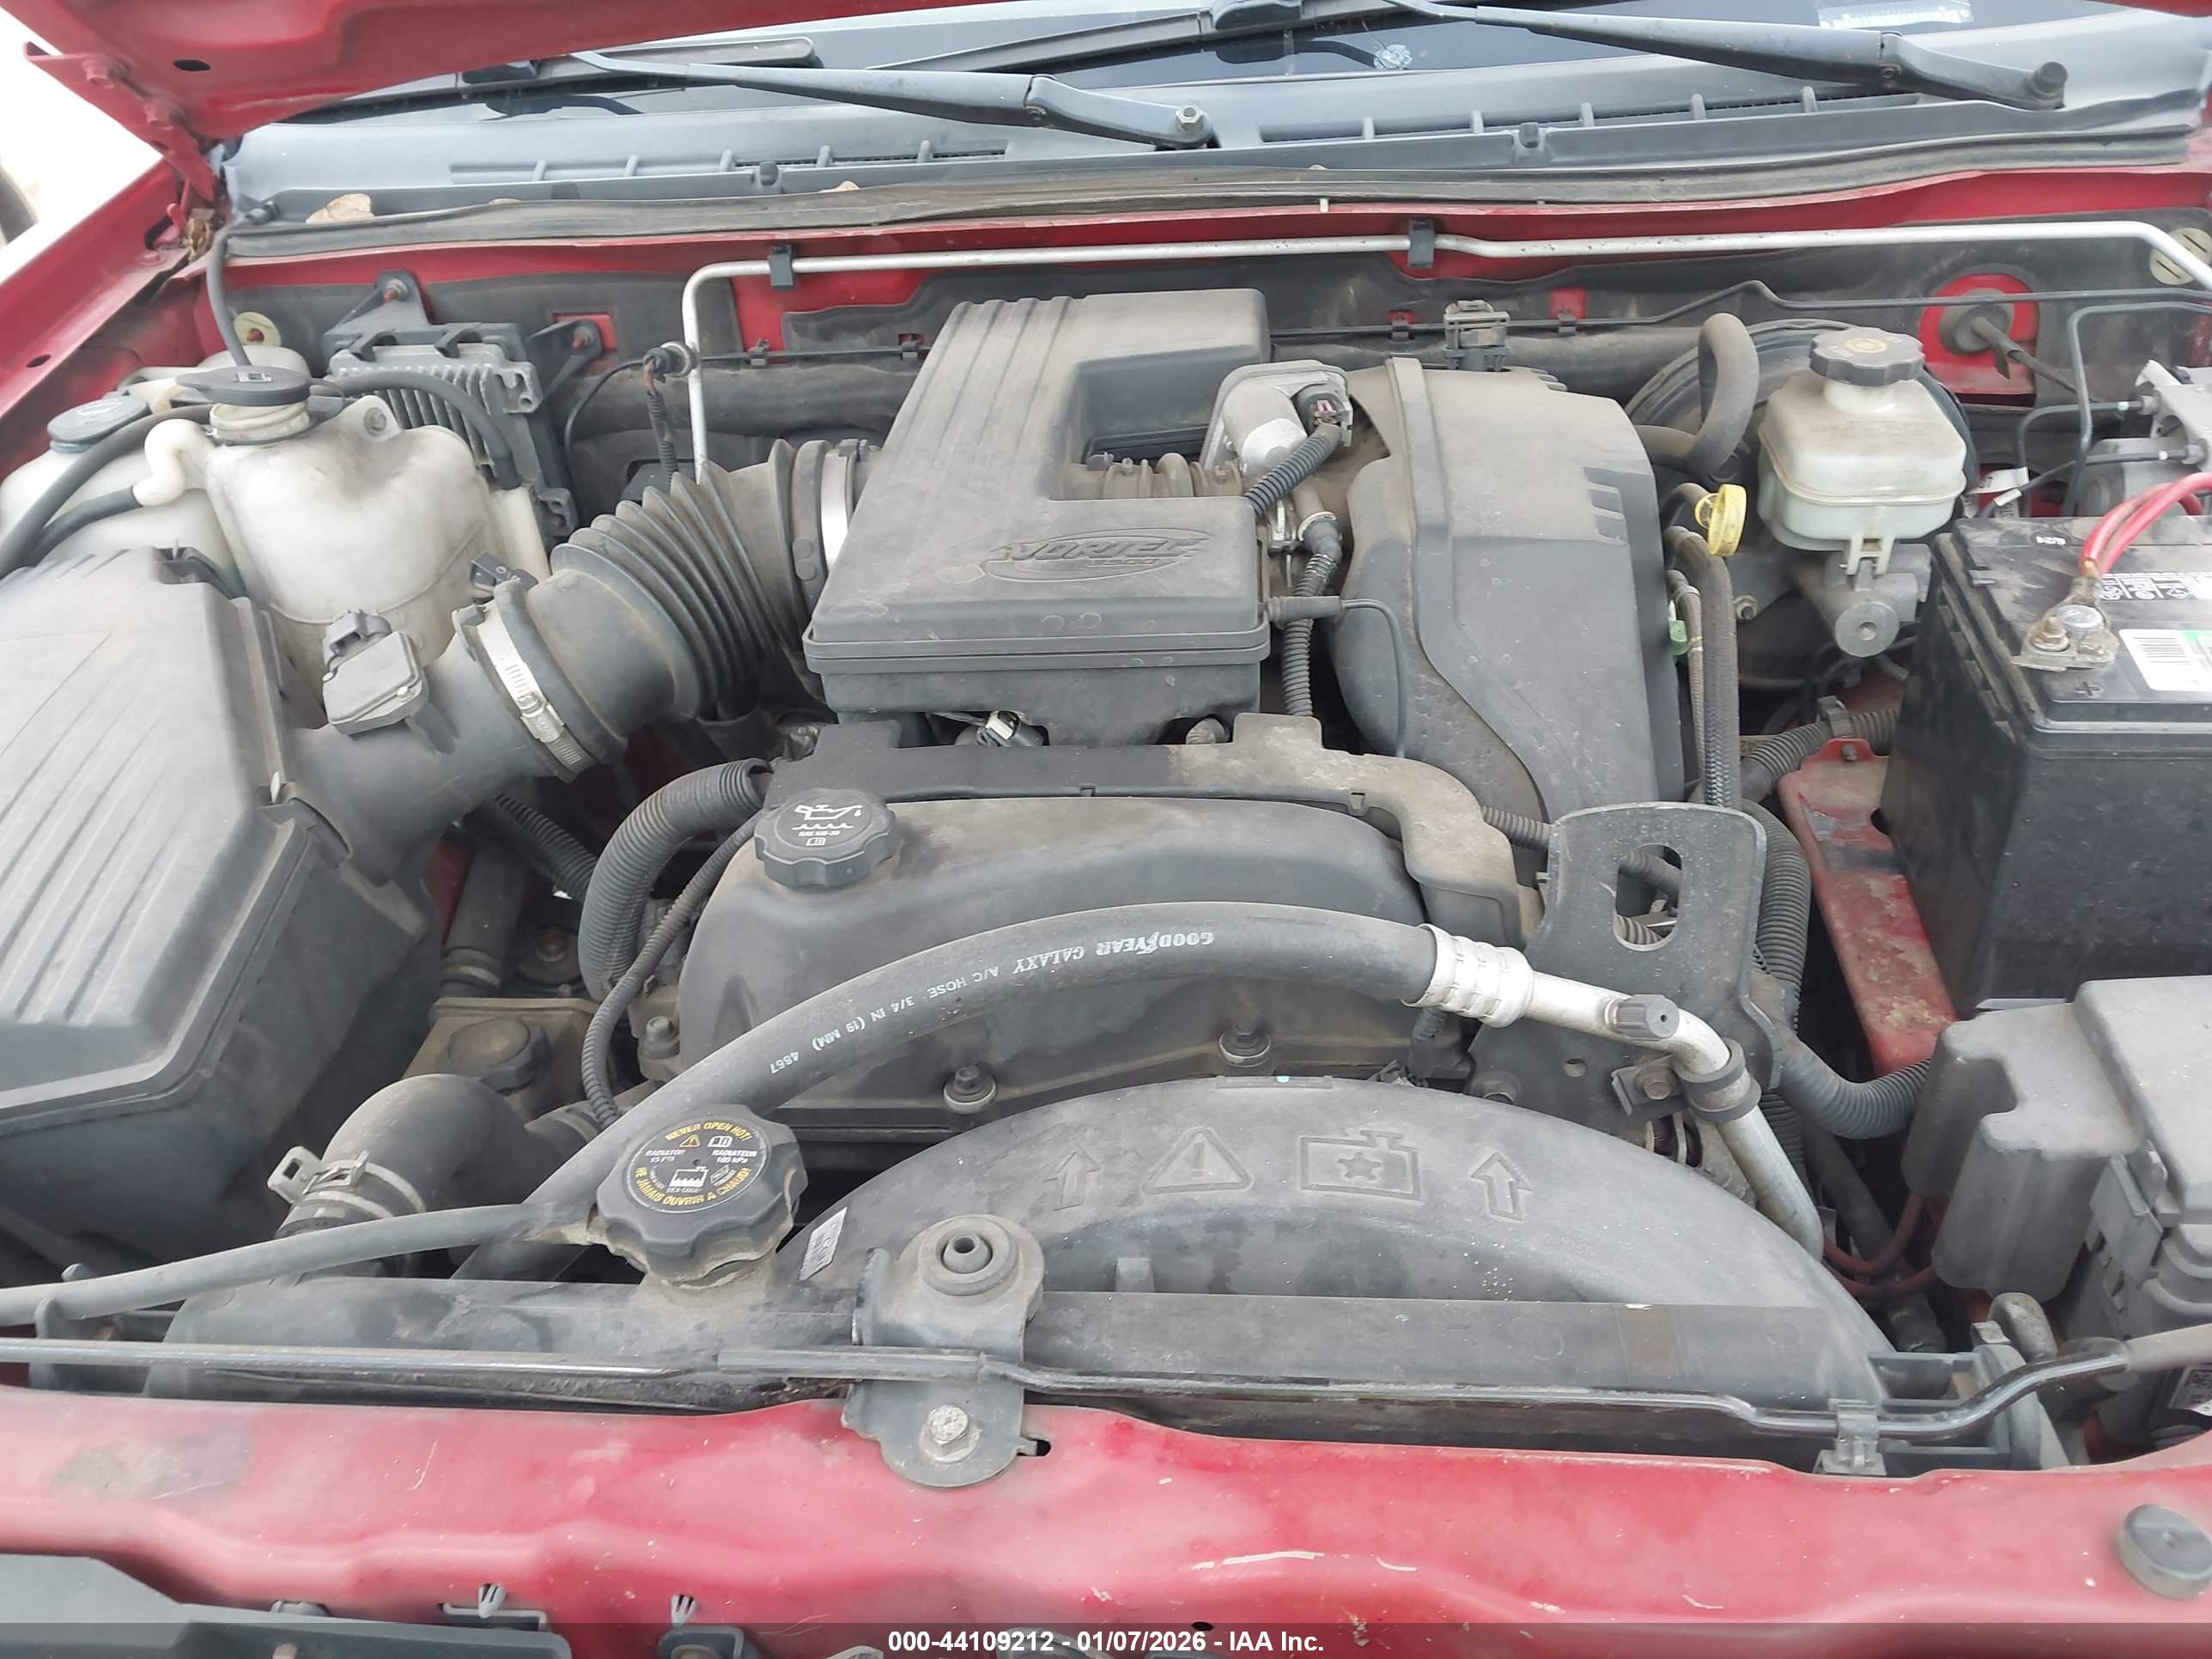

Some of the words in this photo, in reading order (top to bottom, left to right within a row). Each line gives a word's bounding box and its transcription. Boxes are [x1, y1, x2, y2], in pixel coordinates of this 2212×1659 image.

[1096, 931, 1215, 956] GOODYEAR
[1012, 946, 1085, 974] GALAXY
[972, 965, 1000, 983] A/C
[927, 977, 968, 999] HOSE
[890, 996, 915, 1013] 3/4
[870, 1007, 887, 1023] IN
[665, 1124, 702, 1141] NEVER
[703, 1121, 732, 1133] OPEN
